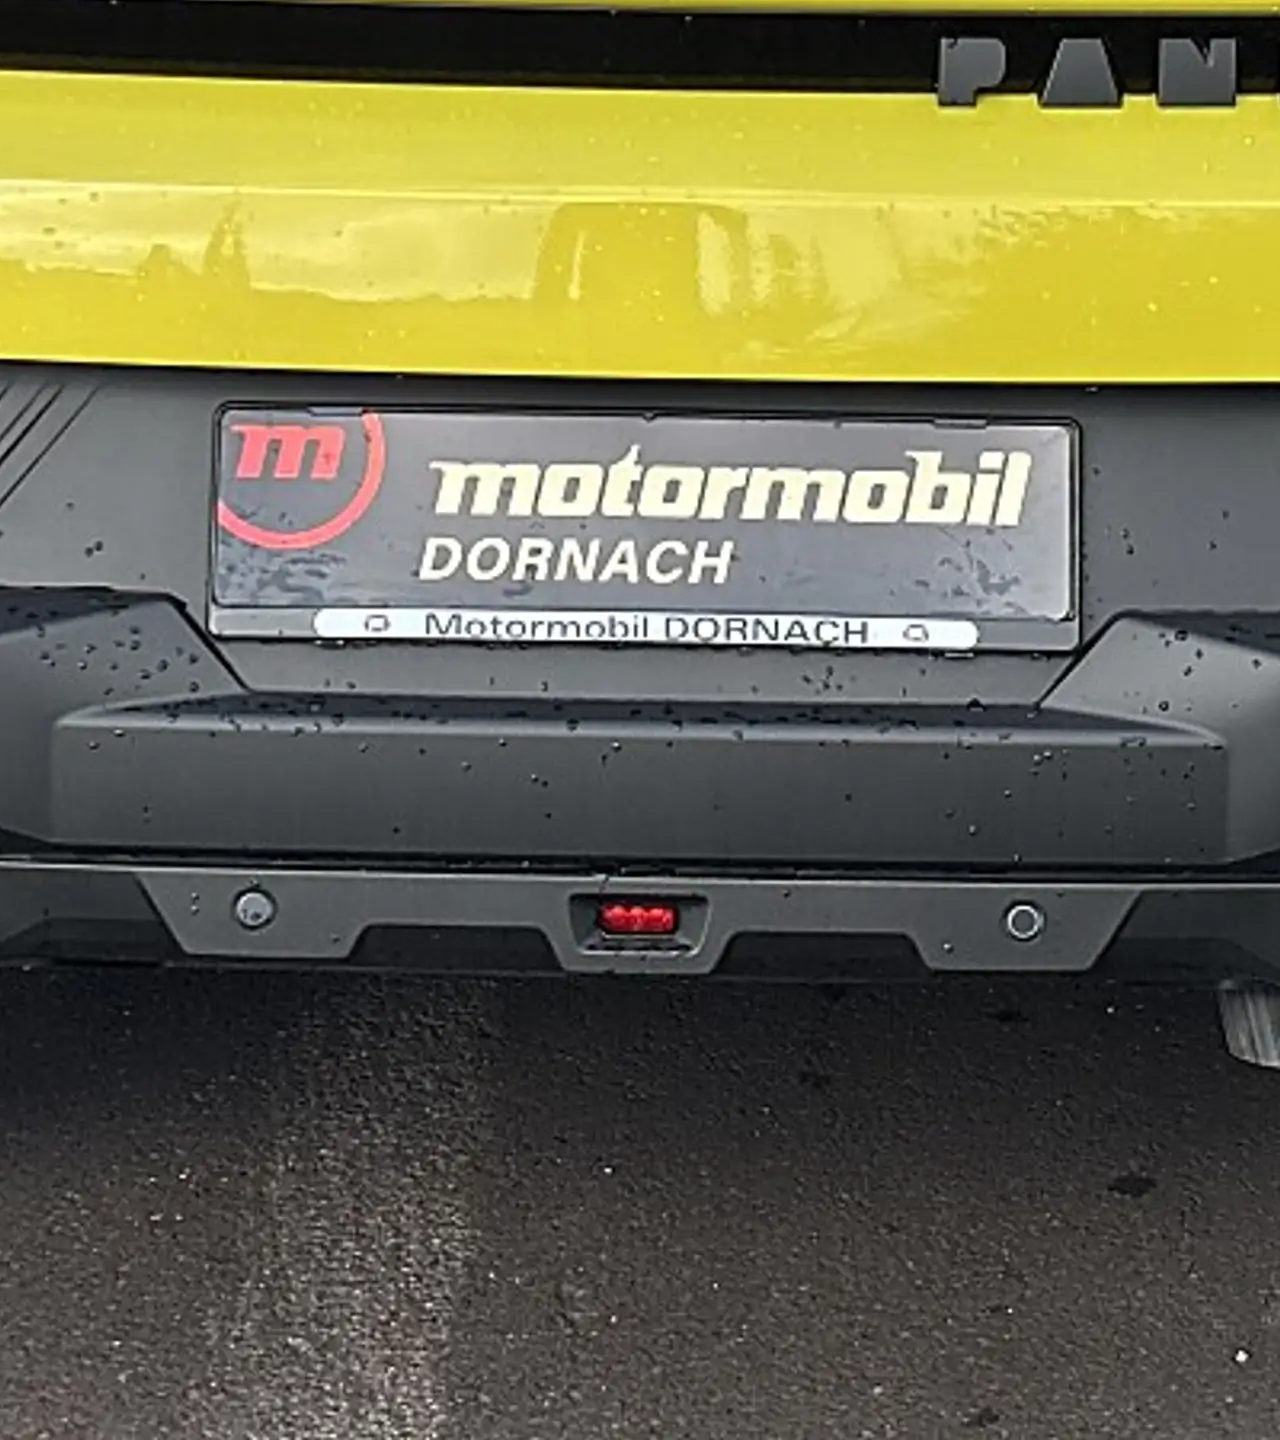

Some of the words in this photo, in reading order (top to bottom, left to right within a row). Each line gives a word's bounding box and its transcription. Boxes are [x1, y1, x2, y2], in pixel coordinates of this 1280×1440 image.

[429, 444, 1032, 526] motormobil
[418, 537, 734, 585] DORNACH
[424, 613, 649, 639] Motormobil
[665, 616, 869, 644] DORNACH
